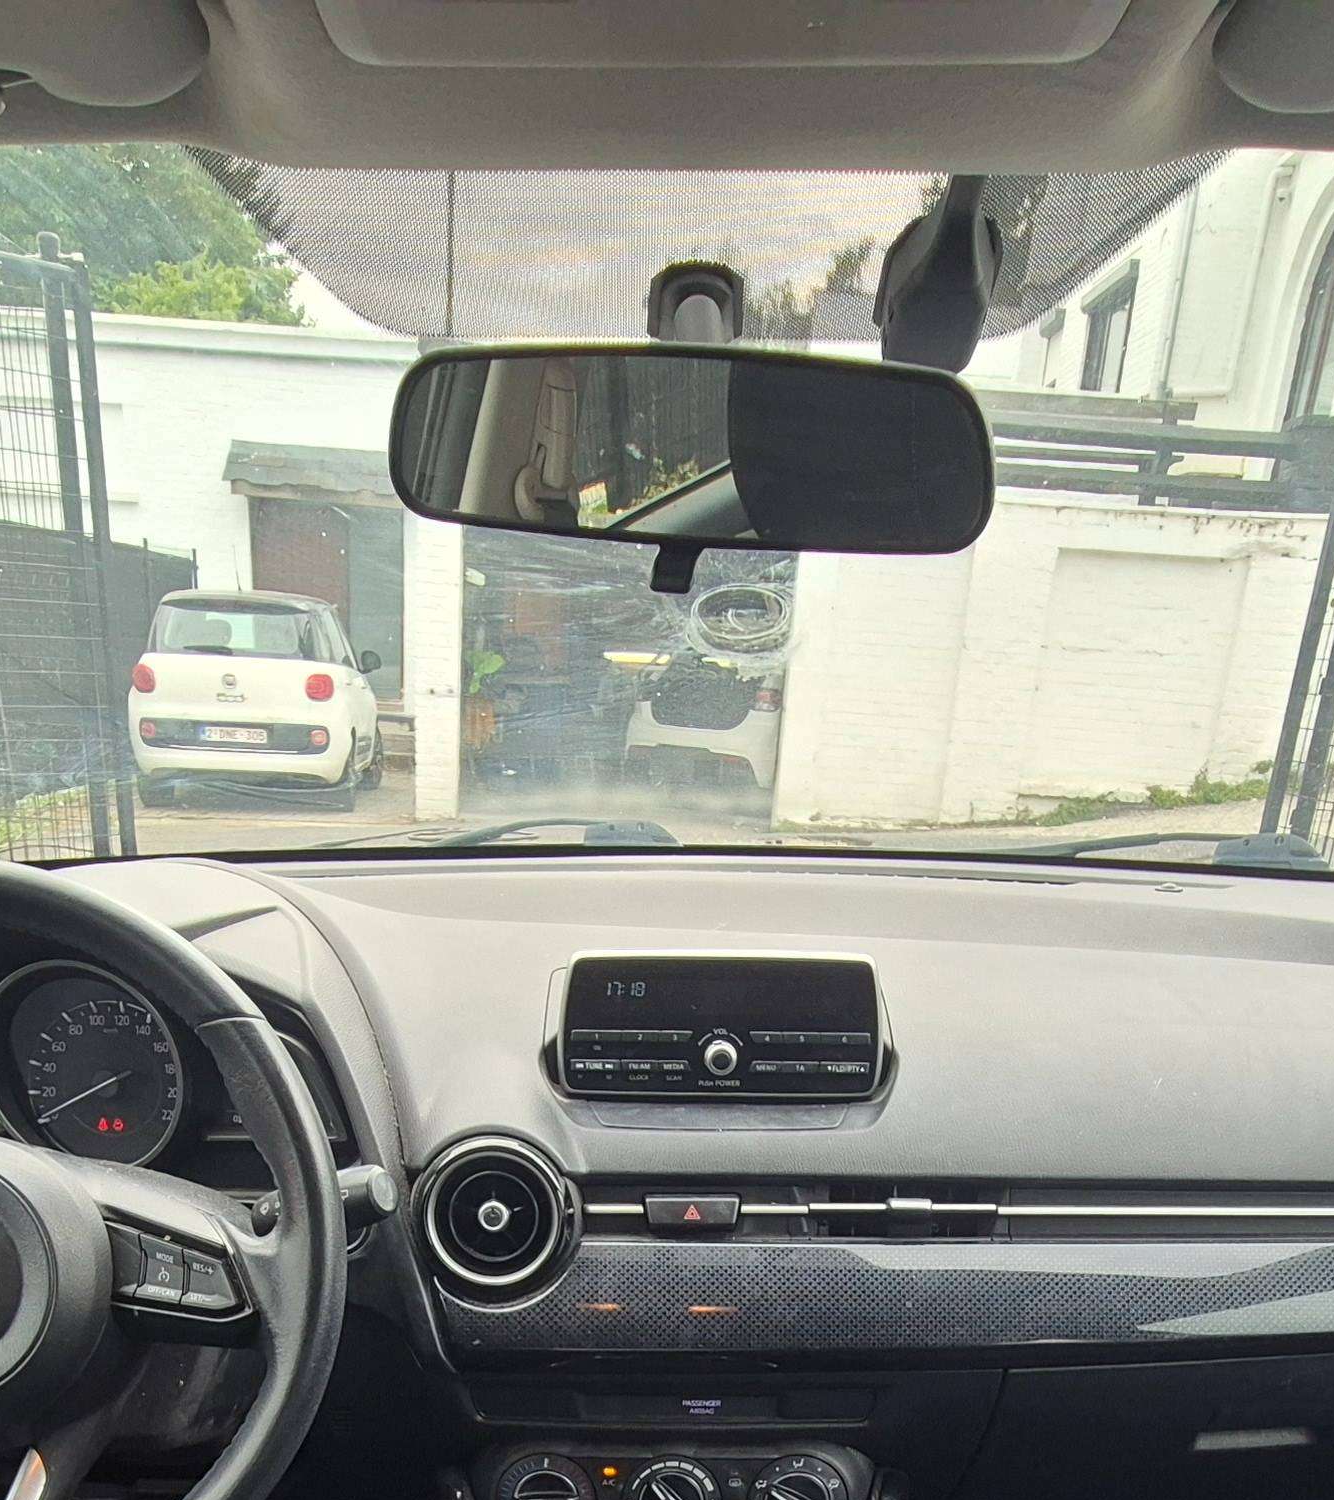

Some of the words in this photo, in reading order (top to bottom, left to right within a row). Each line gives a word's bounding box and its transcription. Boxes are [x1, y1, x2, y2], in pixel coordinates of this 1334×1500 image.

[607, 981, 646, 997] 17:18
[89, 1015, 105, 1026] 100
[115, 1015, 130, 1026] 120
[69, 1025, 83, 1035] 80
[135, 1025, 151, 1036] 140
[713, 1028, 728, 1036] VOL
[52, 1041, 67, 1052] 60
[153, 1042, 169, 1053] 160
[42, 1062, 56, 1073] 40
[42, 1086, 56, 1097] 20
[156, 1252, 174, 1264] MODE
